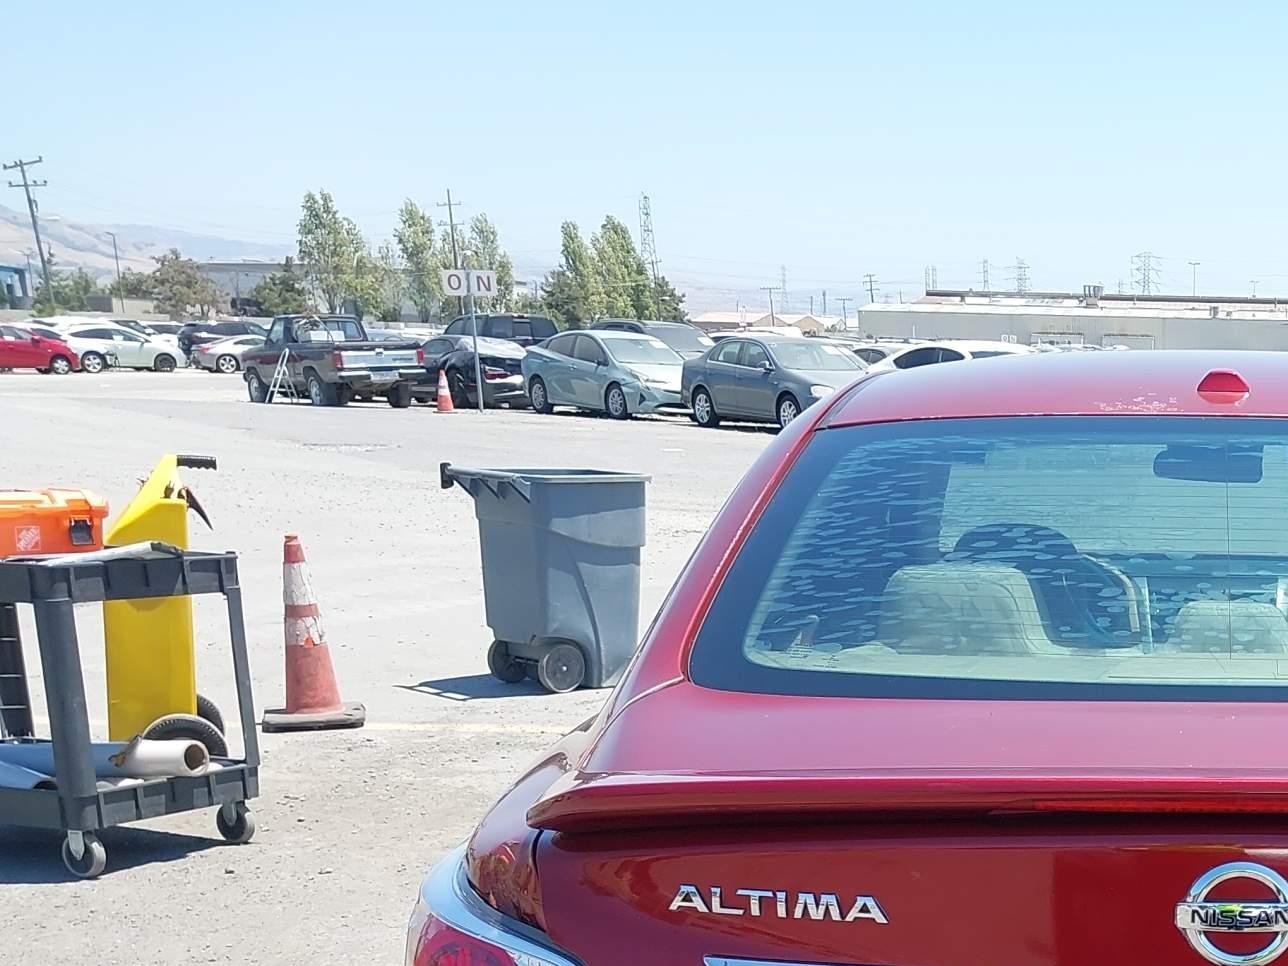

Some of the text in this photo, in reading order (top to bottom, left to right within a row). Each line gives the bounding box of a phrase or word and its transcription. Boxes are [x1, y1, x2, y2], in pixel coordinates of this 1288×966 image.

[447, 273, 462, 290] O
[475, 275, 492, 292] N
[668, 884, 889, 924] ALTIMA
